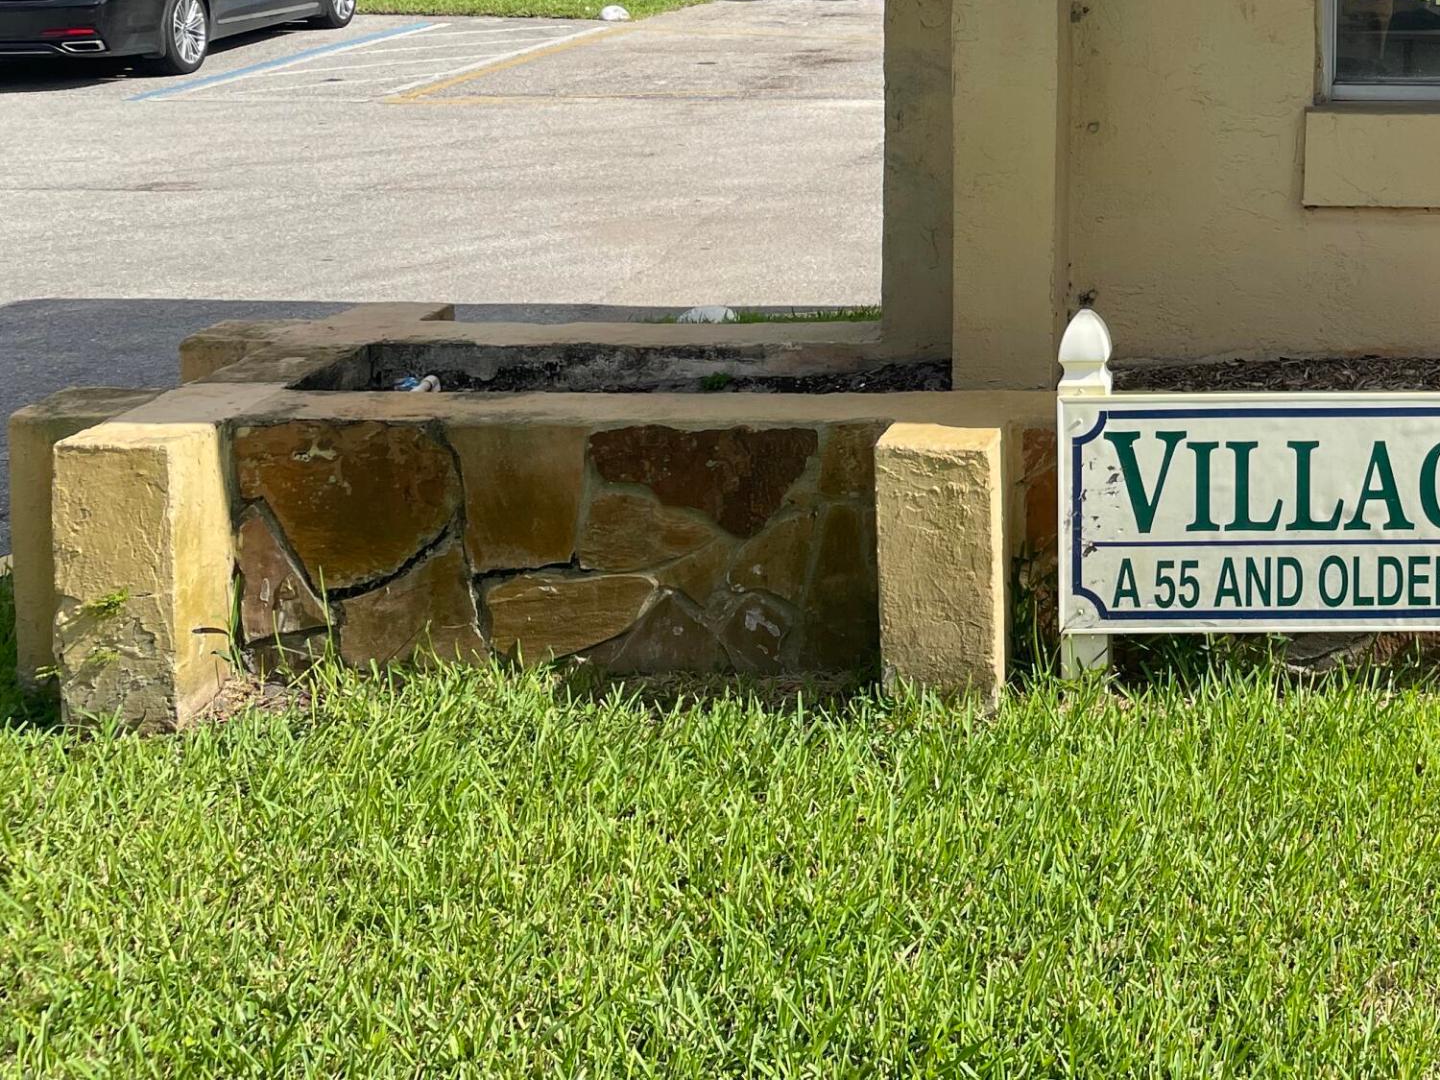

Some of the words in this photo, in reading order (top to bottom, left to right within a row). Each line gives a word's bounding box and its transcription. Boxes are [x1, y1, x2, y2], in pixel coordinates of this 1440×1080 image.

[1112, 557, 1142, 610] A
[1154, 558, 1201, 610] 55
[1214, 557, 1304, 609] AND
